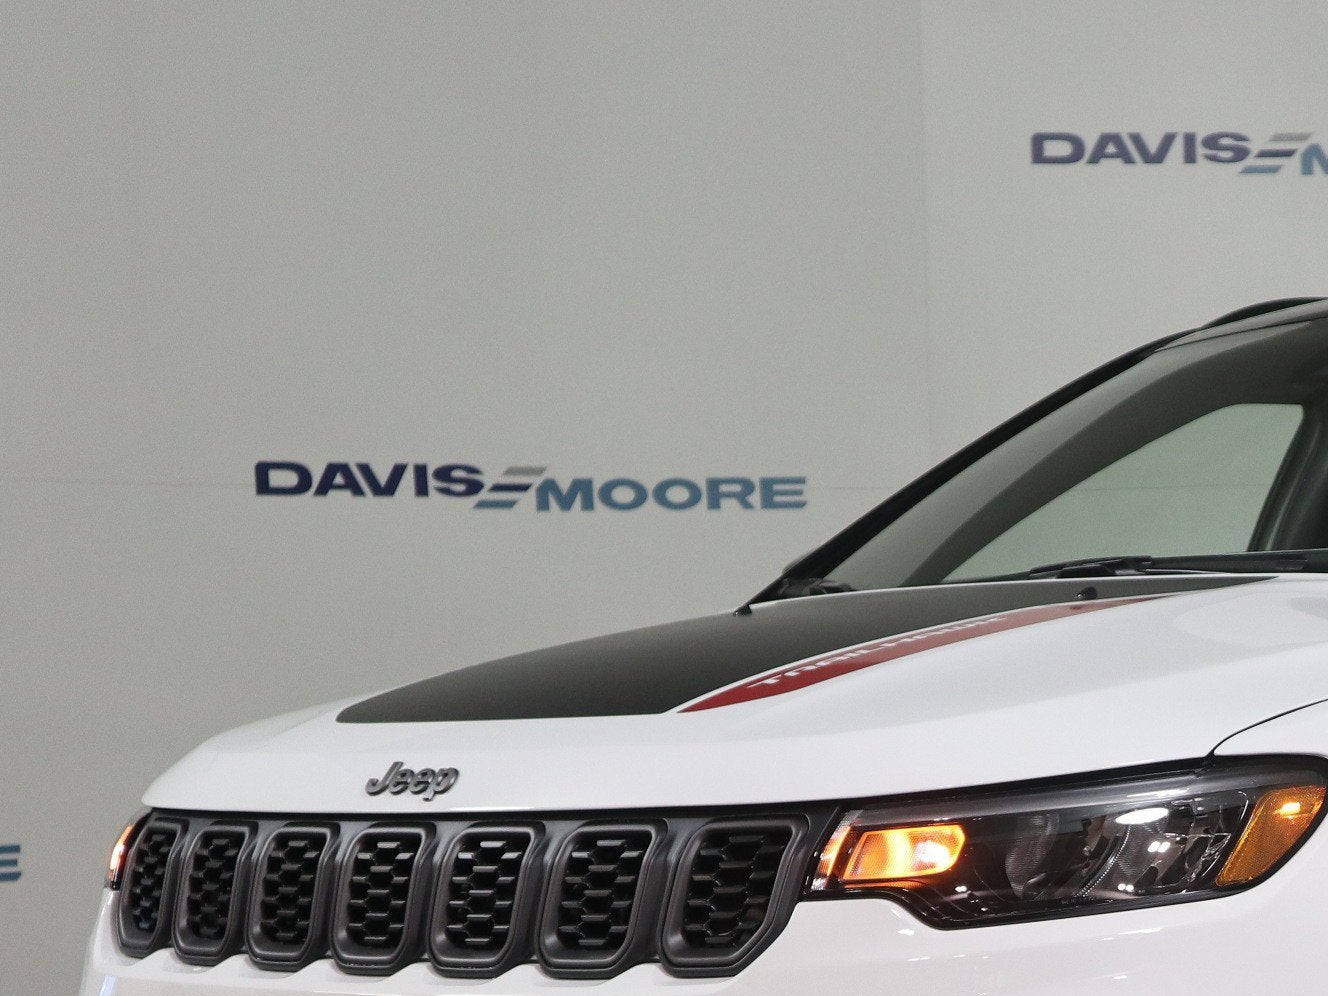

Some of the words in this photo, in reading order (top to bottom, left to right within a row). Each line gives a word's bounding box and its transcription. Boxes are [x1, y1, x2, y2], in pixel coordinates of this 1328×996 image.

[1030, 131, 1250, 165] DAVIS
[254, 460, 485, 497] DAVIS
[535, 475, 808, 512] MOORE
[365, 761, 459, 802] Jeep
